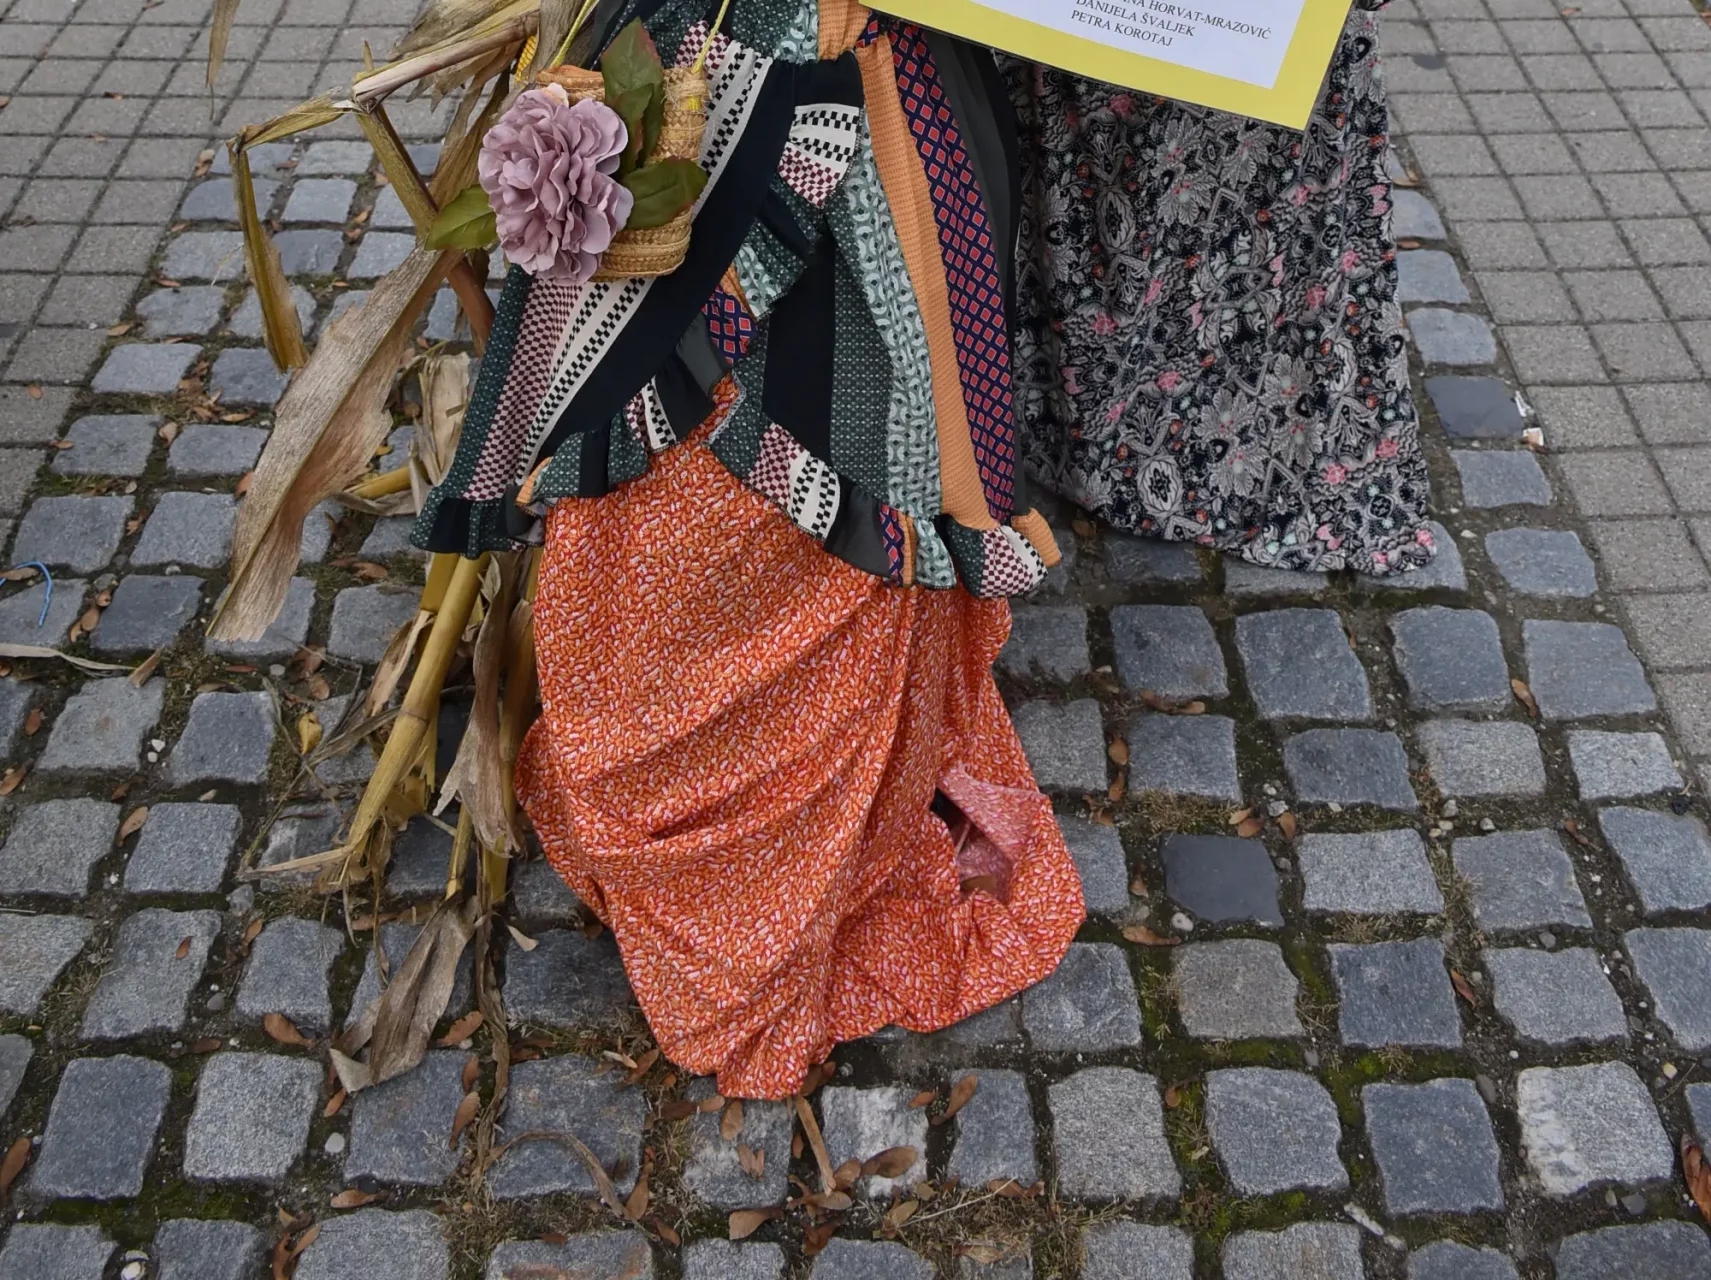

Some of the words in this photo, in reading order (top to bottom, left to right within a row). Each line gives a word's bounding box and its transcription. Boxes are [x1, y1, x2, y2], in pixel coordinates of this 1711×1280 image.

[1070, 9, 1111, 31] PETRA
[1114, 22, 1174, 47] KOROTAJ
[1140, 11, 1196, 37] ŠVALJEK
[1148, 0, 1272, 40] HORVAT-MRAZOVIĆ
